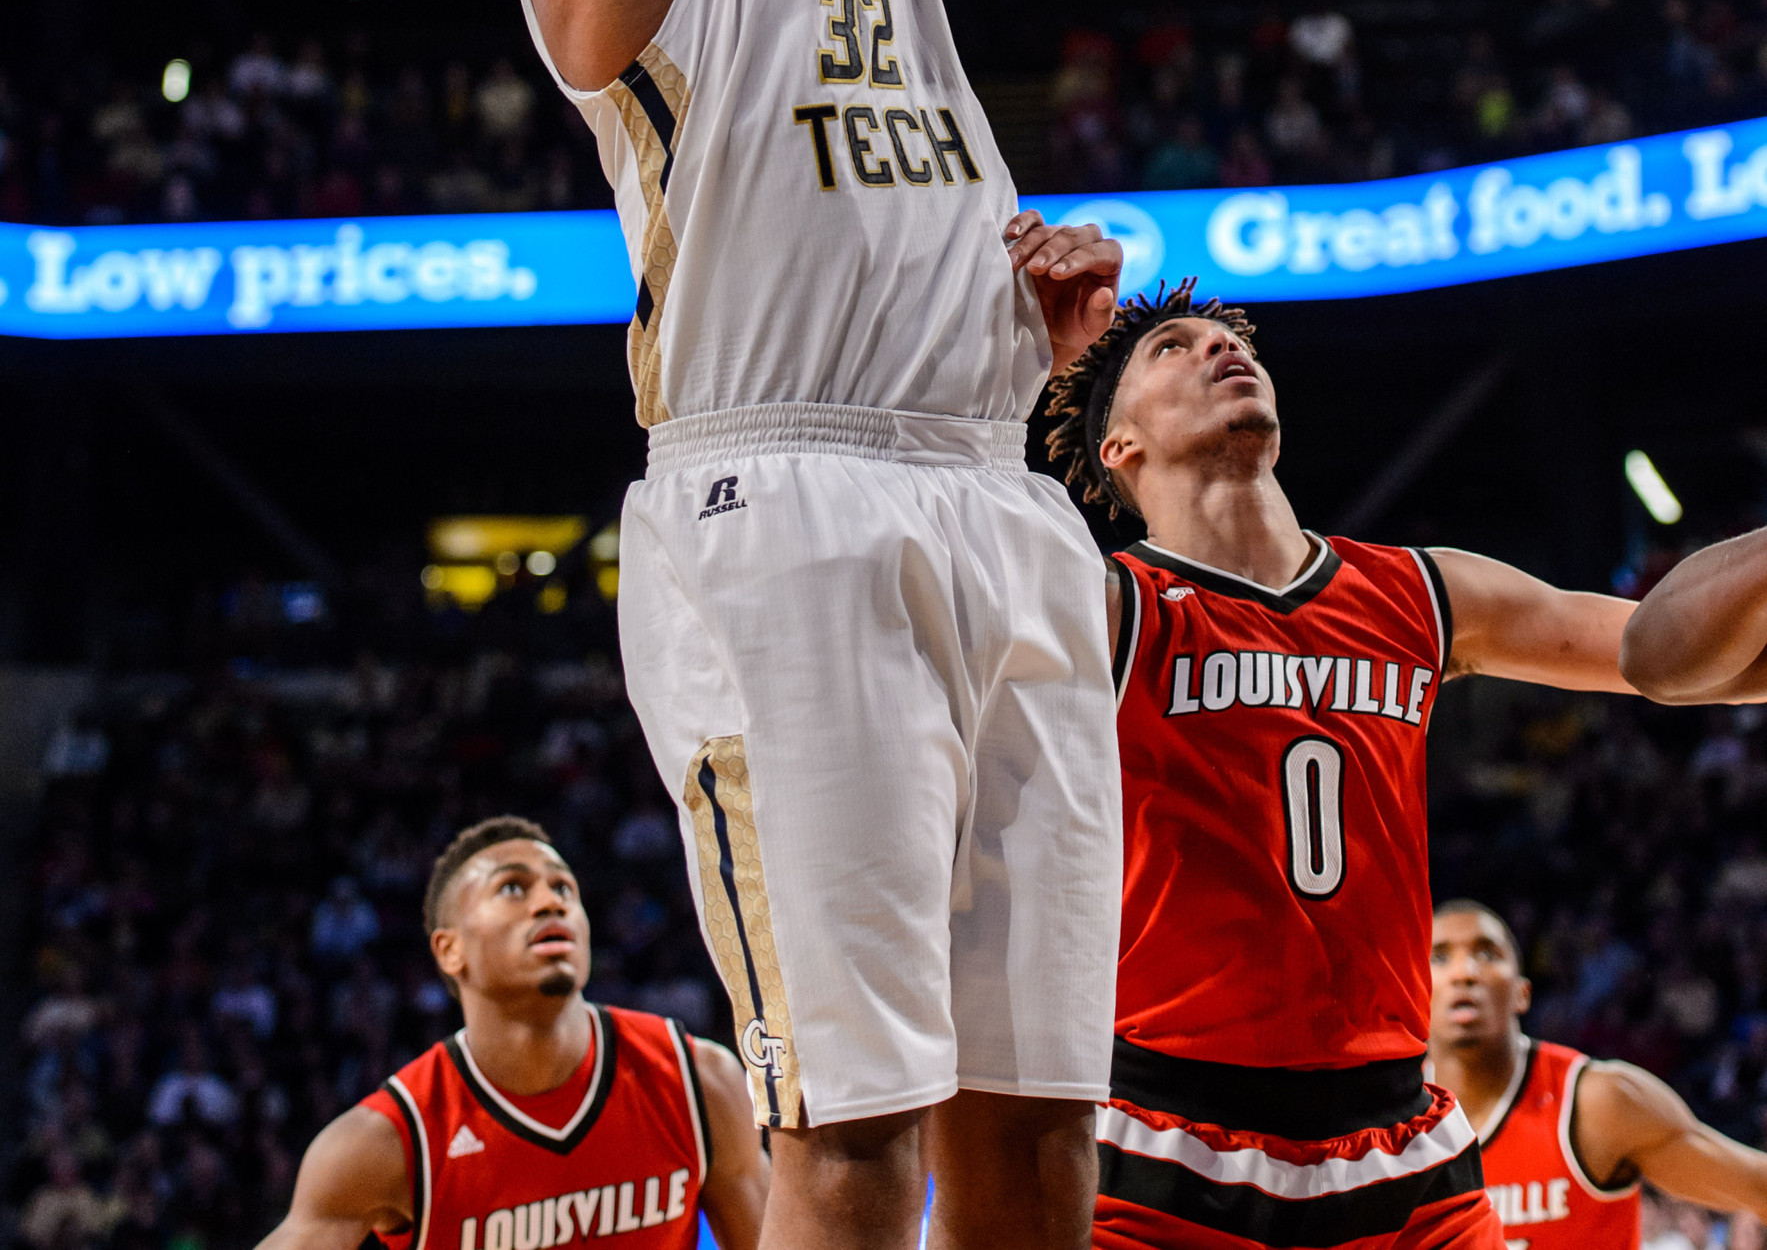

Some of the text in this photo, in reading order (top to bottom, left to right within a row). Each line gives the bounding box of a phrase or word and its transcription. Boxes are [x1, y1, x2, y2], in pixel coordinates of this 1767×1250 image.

[793, 103, 983, 192] TECH
[1206, 190, 1462, 278] Great
[1465, 144, 1672, 256] food.
[26, 223, 537, 330] Low prices.
[699, 500, 747, 520] RUSSELL
[1165, 652, 1434, 726] LOUISVILLE
[1281, 734, 1348, 902] 0
[741, 1017, 787, 1079] GT
[459, 1167, 691, 1250] LOUISVILLE
